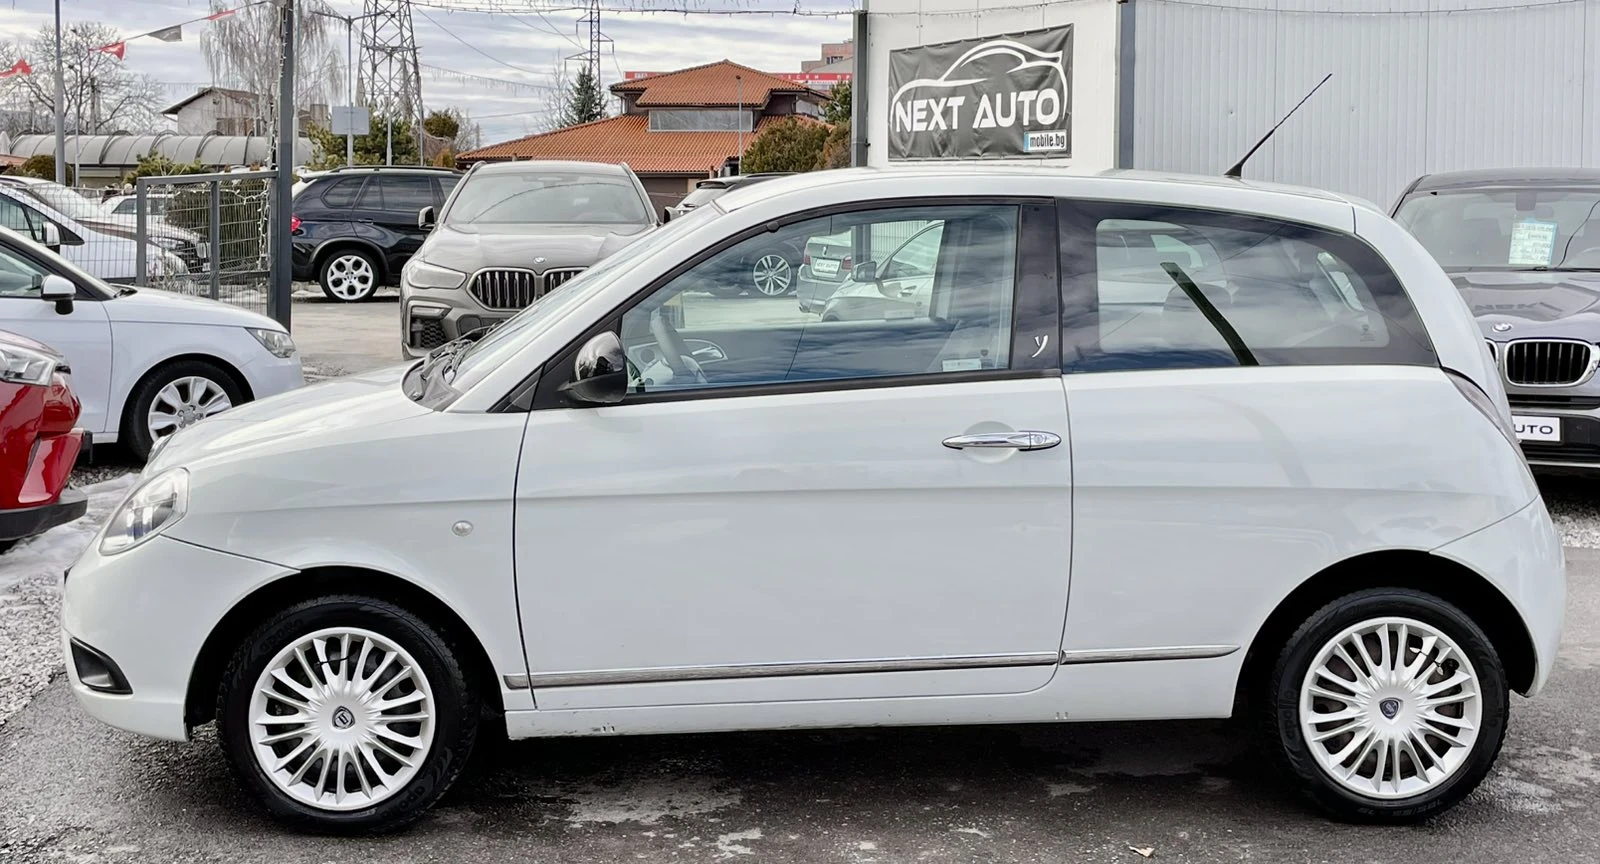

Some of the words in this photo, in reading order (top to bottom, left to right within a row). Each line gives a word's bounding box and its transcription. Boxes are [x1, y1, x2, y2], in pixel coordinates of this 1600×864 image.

[895, 95, 966, 133] NEXT
[972, 88, 1060, 129] AUTO
[1030, 134, 1065, 148] mobile.bg
[1514, 424, 1553, 435] UTO
